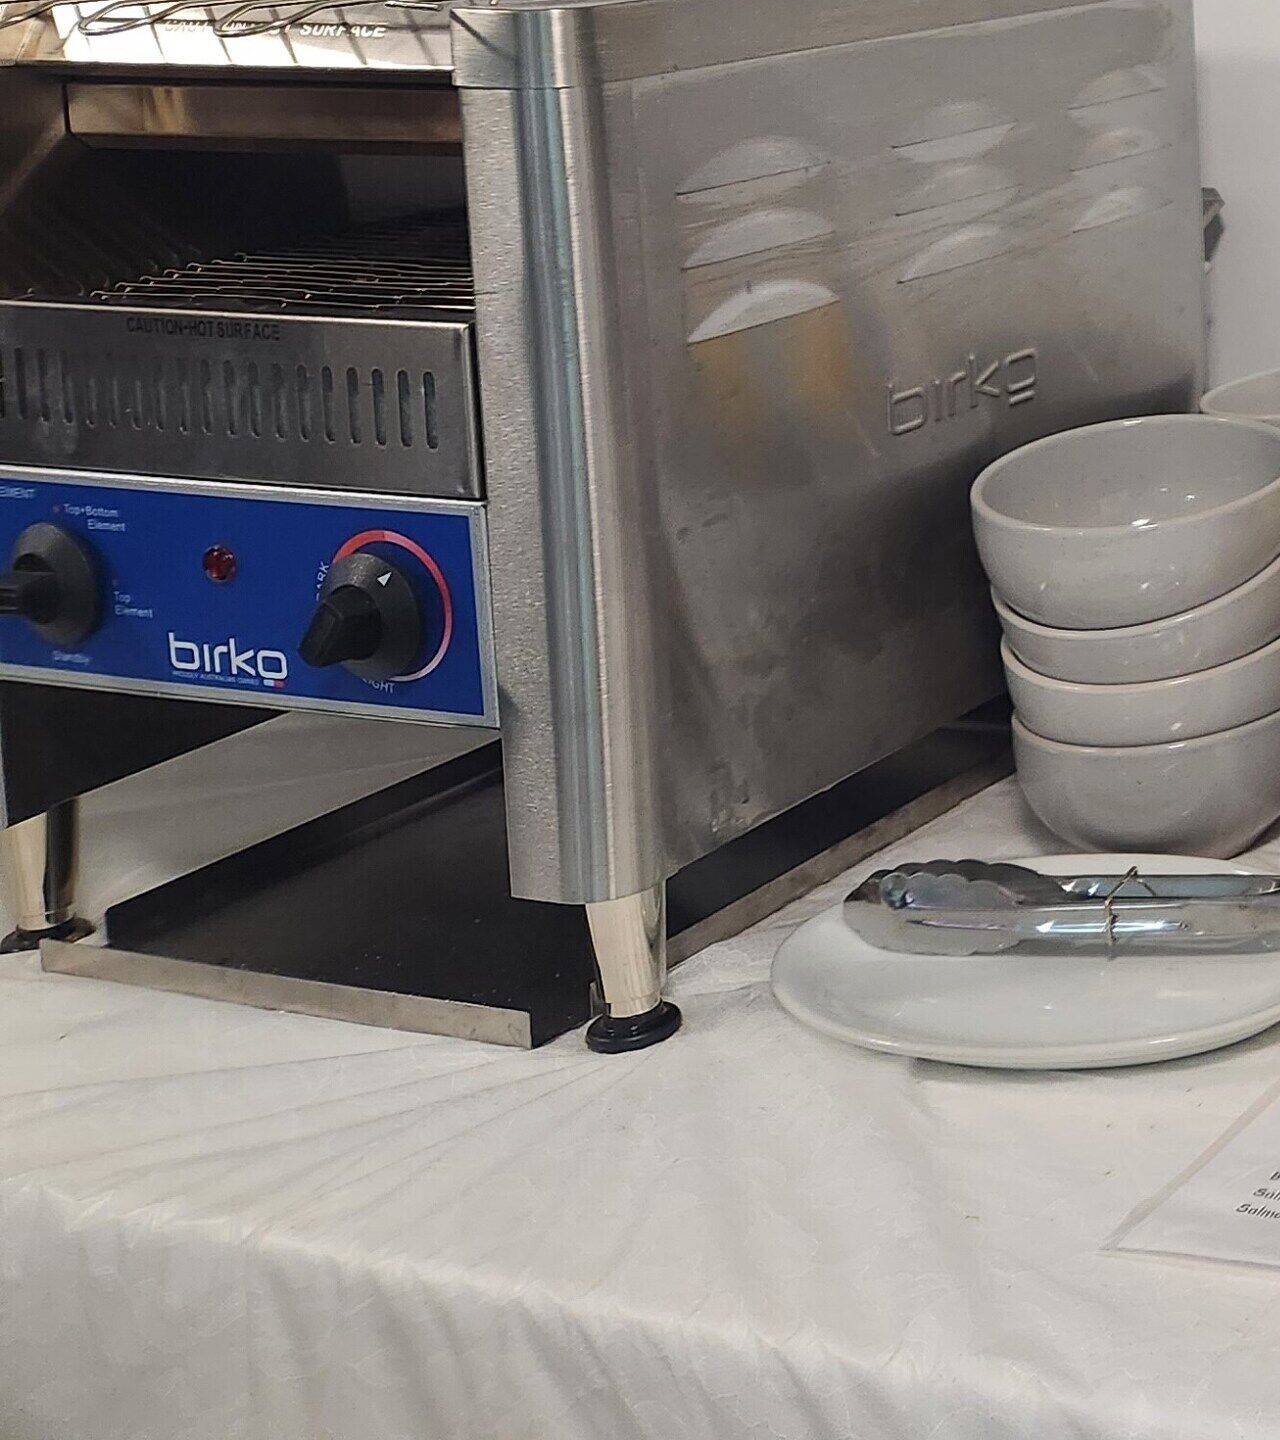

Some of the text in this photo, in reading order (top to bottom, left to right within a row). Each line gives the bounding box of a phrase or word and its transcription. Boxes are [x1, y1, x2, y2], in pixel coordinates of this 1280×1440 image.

[218, 322, 280, 341] SURFACE
[886, 347, 1038, 436] birko
[87, 519, 126, 532] Element
[114, 591, 131, 603] Top
[115, 605, 153, 618] Element
[168, 632, 288, 680] birko
[363, 677, 396, 694] IGHT
